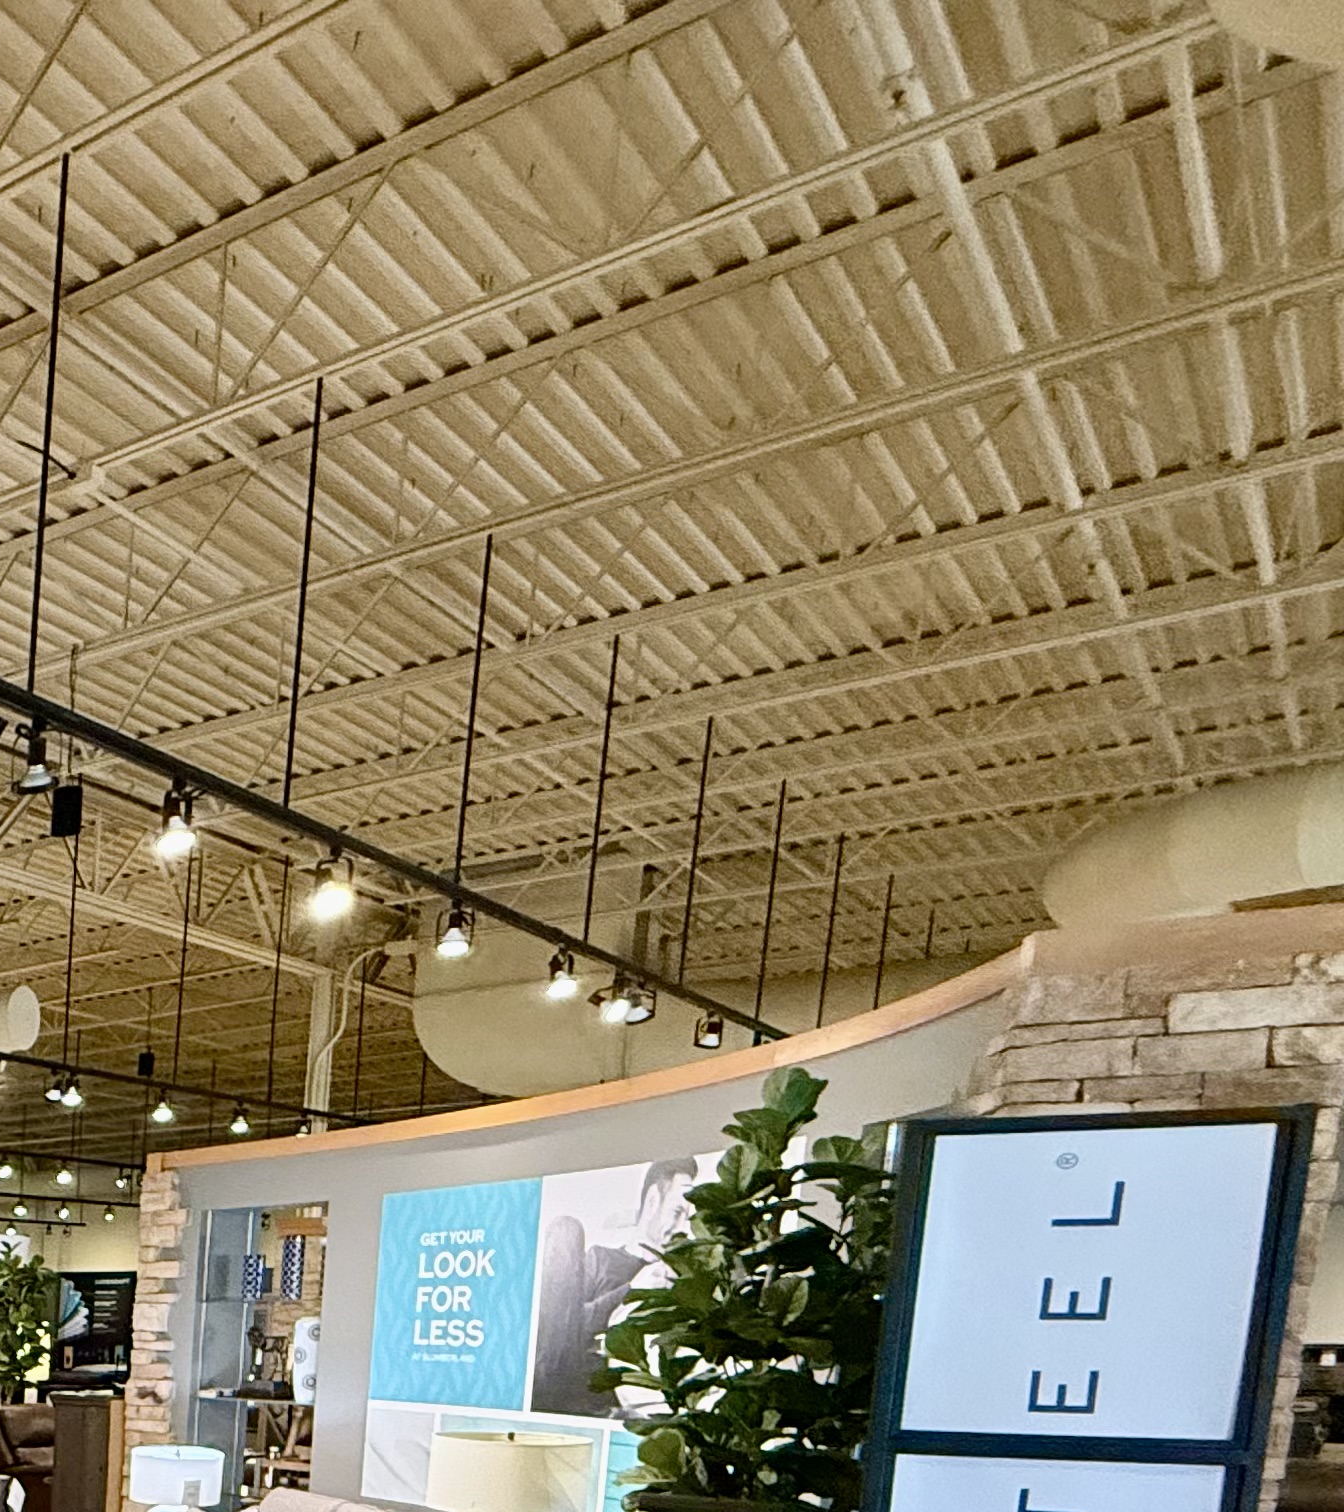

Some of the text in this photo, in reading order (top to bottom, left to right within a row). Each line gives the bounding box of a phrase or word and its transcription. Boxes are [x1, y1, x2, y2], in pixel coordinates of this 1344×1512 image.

[419, 1228, 486, 1247] GET YOUR
[418, 1248, 497, 1279] LOOK
[415, 1285, 472, 1313] FOR
[413, 1318, 485, 1348] LESS
